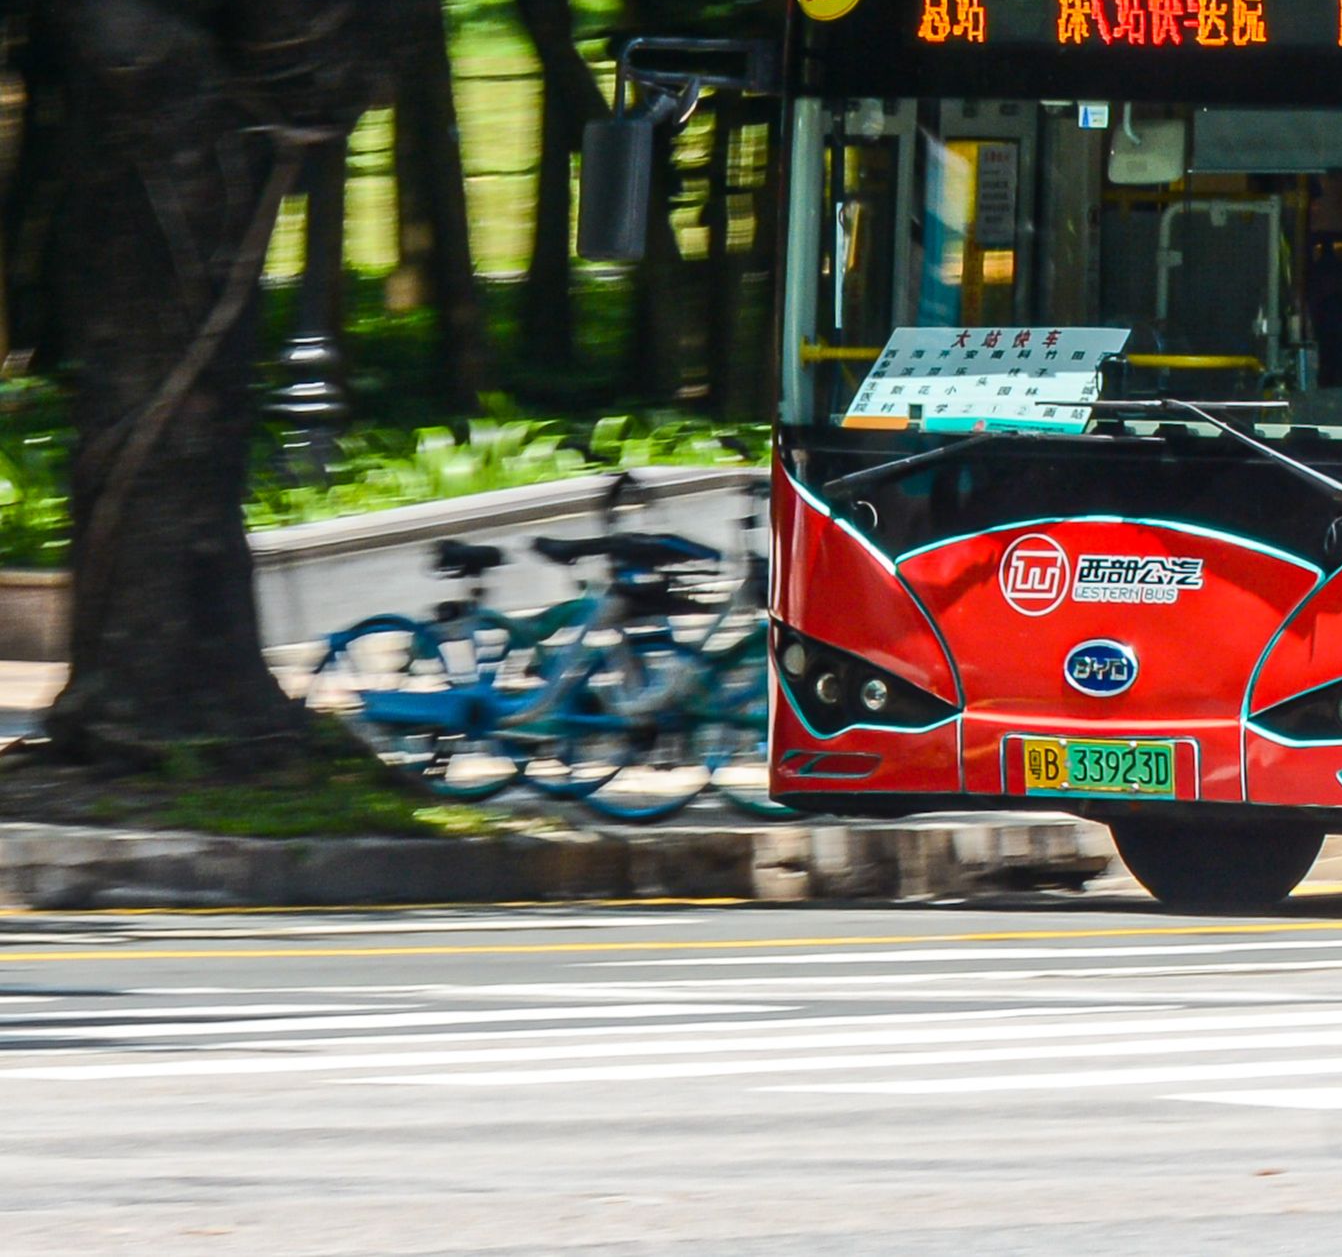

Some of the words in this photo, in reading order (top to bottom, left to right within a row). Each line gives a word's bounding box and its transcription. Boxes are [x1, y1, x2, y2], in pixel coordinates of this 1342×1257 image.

[951, 329, 1062, 349] 大站快车
[1078, 557, 1201, 584] 西部公汽
[1144, 587, 1176, 602] BUS
[1073, 656, 1129, 681] BYD
[1073, 750, 1169, 785] 33923D
